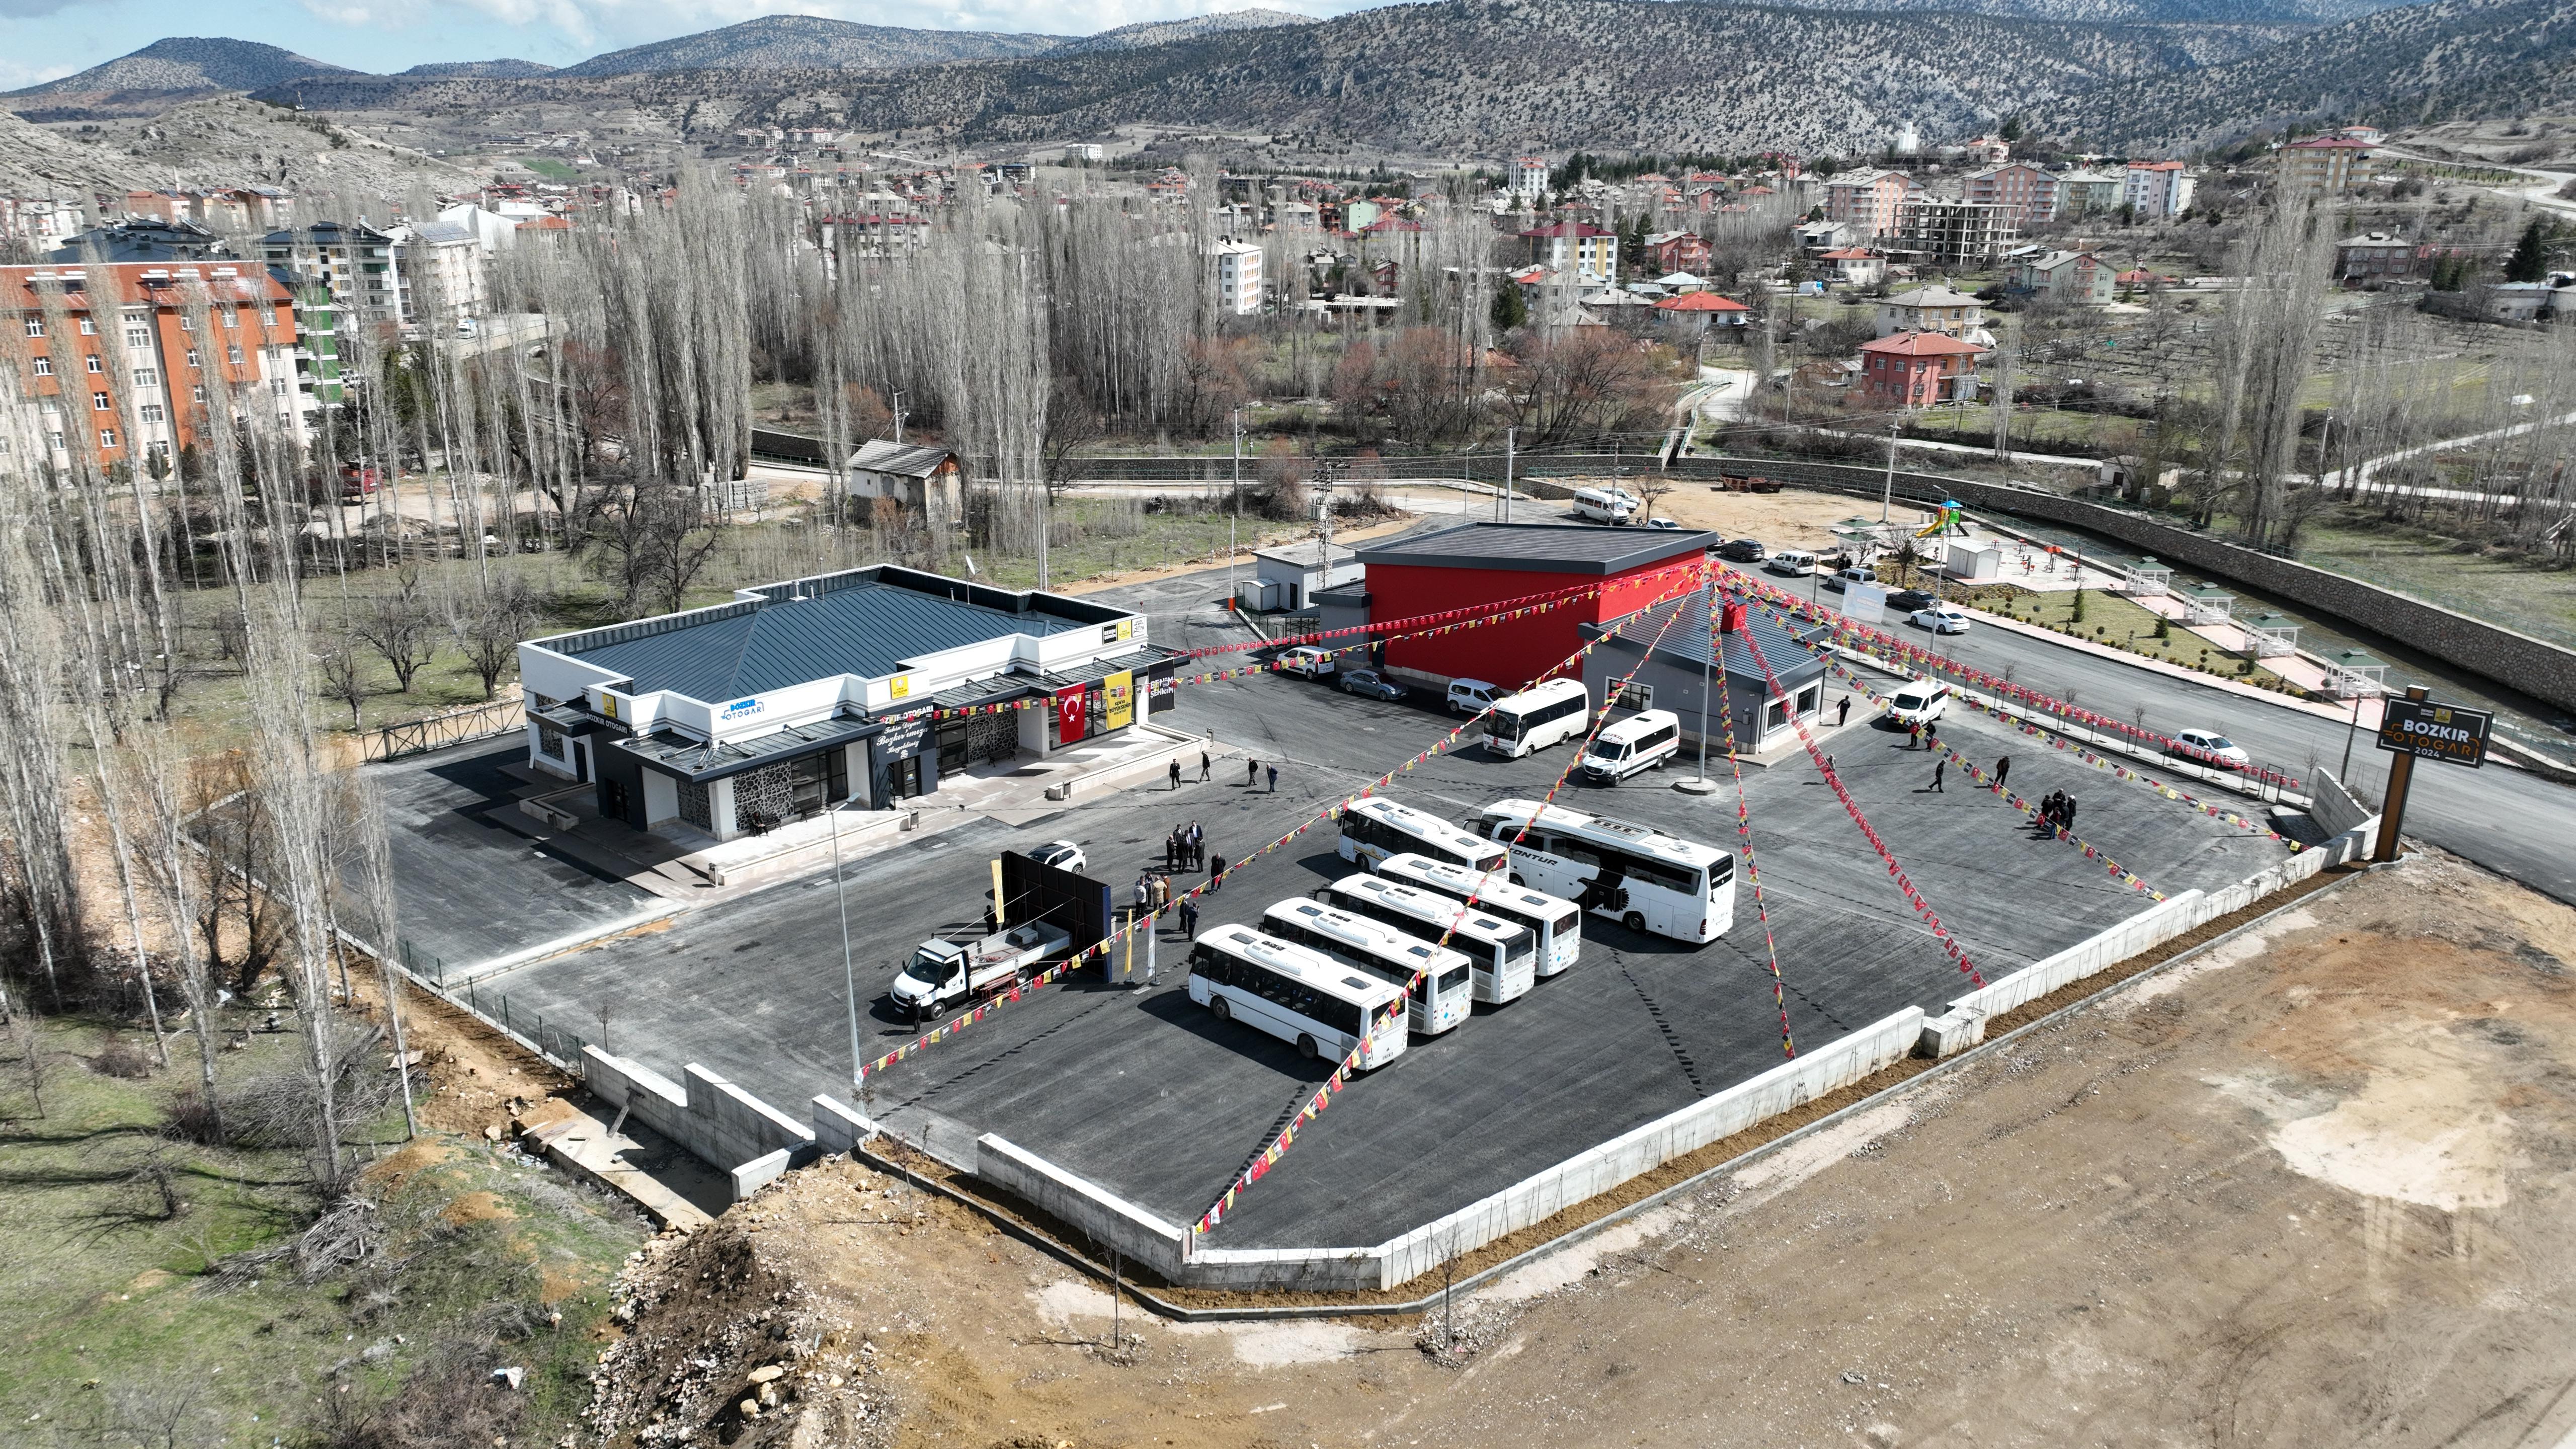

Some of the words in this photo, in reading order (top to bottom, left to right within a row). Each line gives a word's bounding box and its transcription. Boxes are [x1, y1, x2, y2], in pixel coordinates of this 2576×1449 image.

[903, 705, 933, 719] OOGARI
[586, 712, 605, 726] BOZKIR
[605, 720, 627, 734] OTOGARI
[2403, 719, 2469, 743] BOZKIR
[2393, 732, 2479, 757] OTOGARI
[2415, 747, 2440, 758] 2024
[1712, 868, 1733, 883] KONTUR
